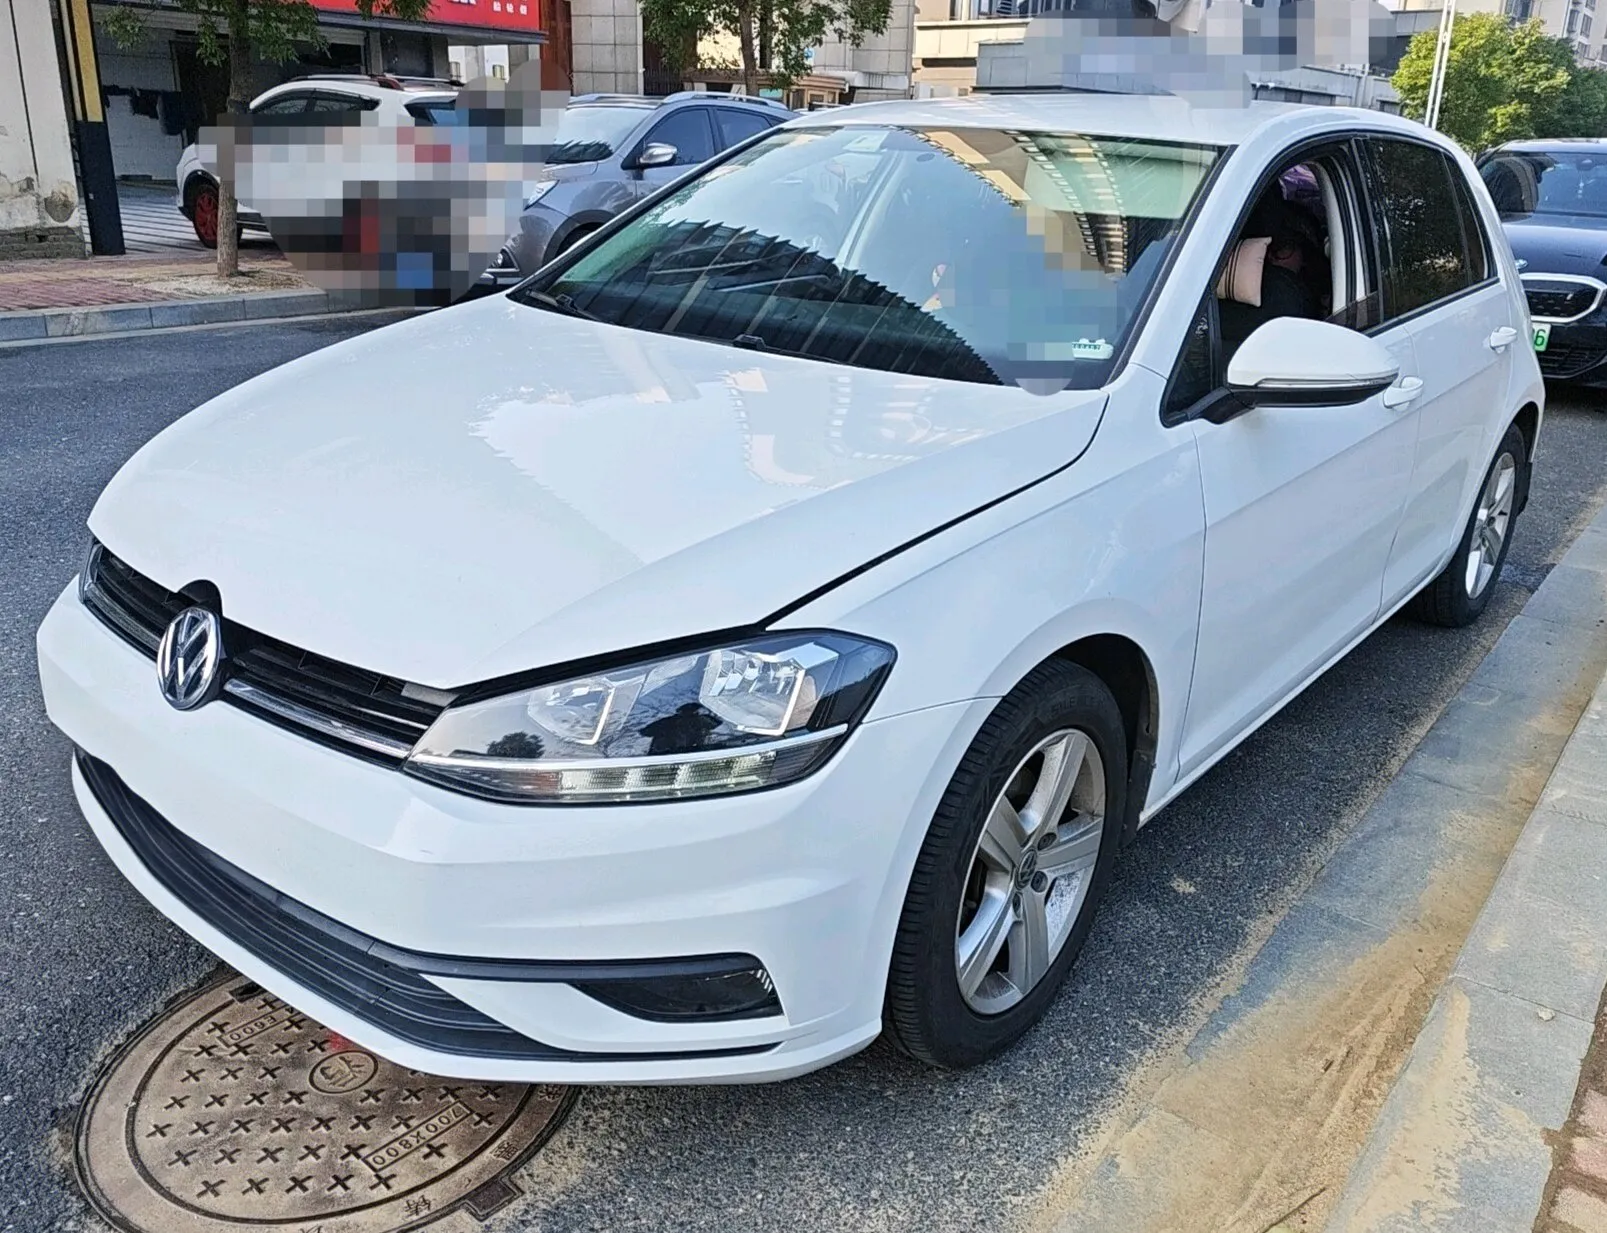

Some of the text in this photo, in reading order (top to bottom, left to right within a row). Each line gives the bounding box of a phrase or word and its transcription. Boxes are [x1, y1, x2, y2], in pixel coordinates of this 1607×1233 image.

[1532, 329, 1546, 347] 6
[229, 1016, 277, 1041] E600
[372, 1106, 461, 1166] 700X800
